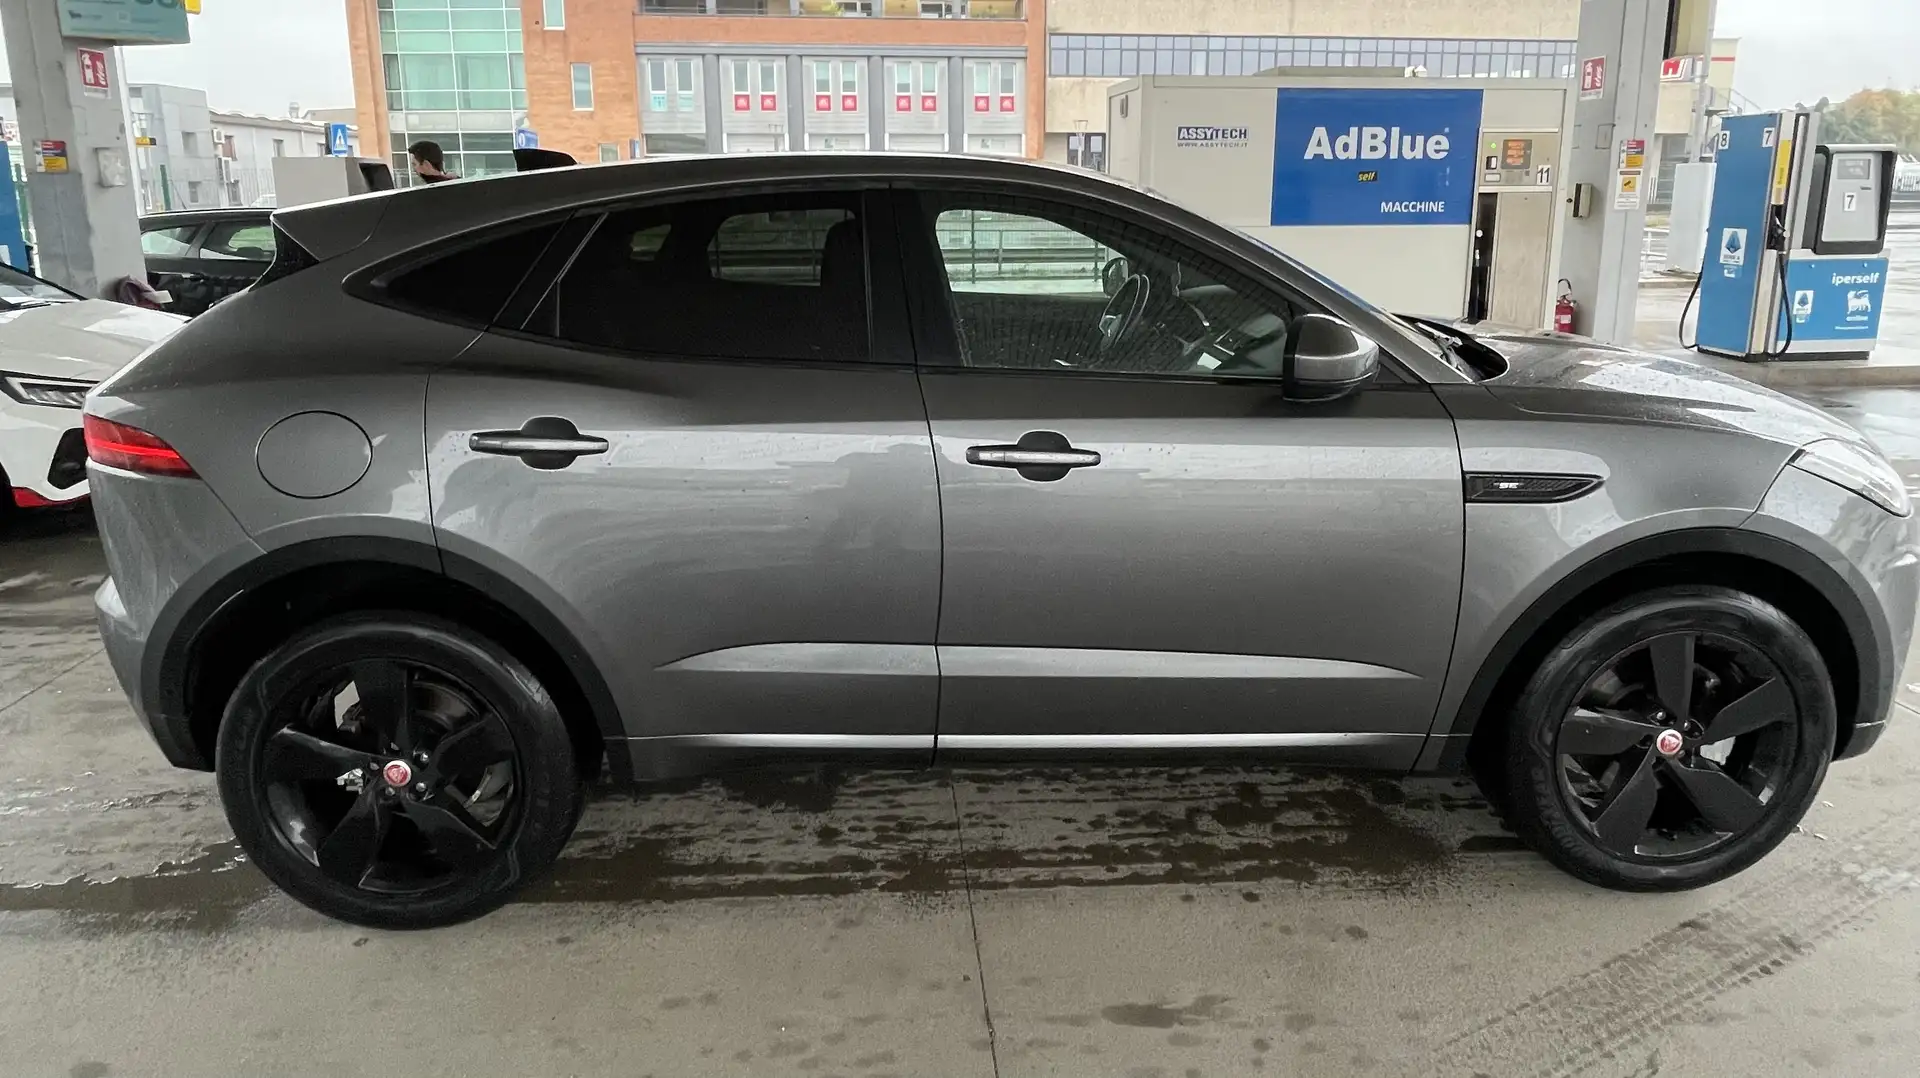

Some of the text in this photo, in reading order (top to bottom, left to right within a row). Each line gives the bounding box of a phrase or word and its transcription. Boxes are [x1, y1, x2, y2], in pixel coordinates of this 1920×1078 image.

[1179, 127, 1247, 139] ASSYTECH
[1720, 133, 1728, 147] 8
[1765, 130, 1773, 145] 7
[1304, 126, 1450, 160] AdBlue
[1358, 171, 1375, 181] self
[1537, 167, 1550, 183] 11
[1380, 201, 1445, 213] MACCHINE
[1846, 194, 1855, 209] 7
[1831, 272, 1880, 286] iperself
